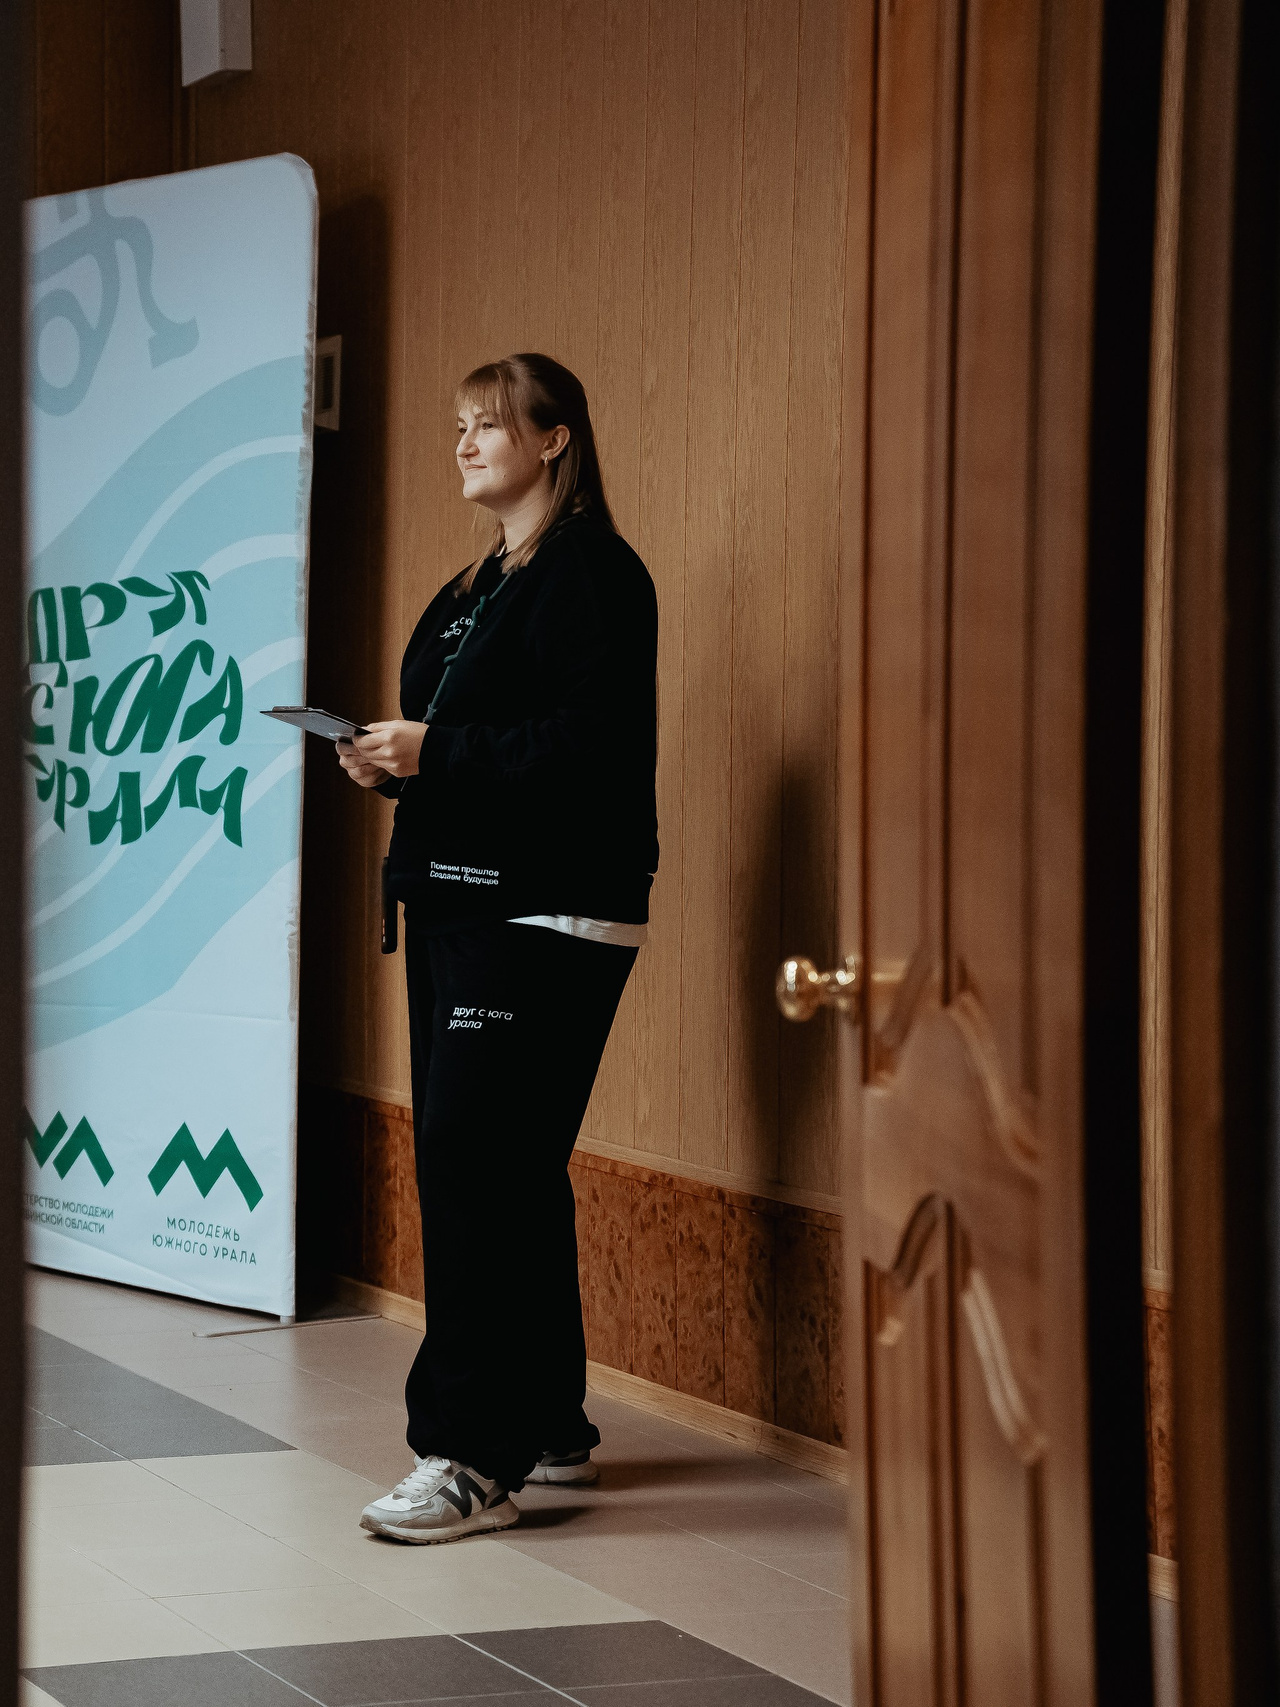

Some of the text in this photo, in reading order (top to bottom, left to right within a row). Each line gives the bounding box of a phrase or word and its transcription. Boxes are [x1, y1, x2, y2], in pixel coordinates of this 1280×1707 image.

[67, 639, 244, 757] ЮГА
[430, 861, 500, 877] Помним прошлое
[463, 873, 499, 885] будущее
[452, 1006, 514, 1021] друг с юга
[447, 1019, 483, 1030] урала
[62, 1202, 114, 1219] МОЛОДЕЖИ
[64, 1217, 105, 1234] ОБЛАСТИ
[166, 1216, 241, 1242] МОЛОДЕЖЬ
[152, 1234, 257, 1265] ЮЖНОГО УРАЛА
